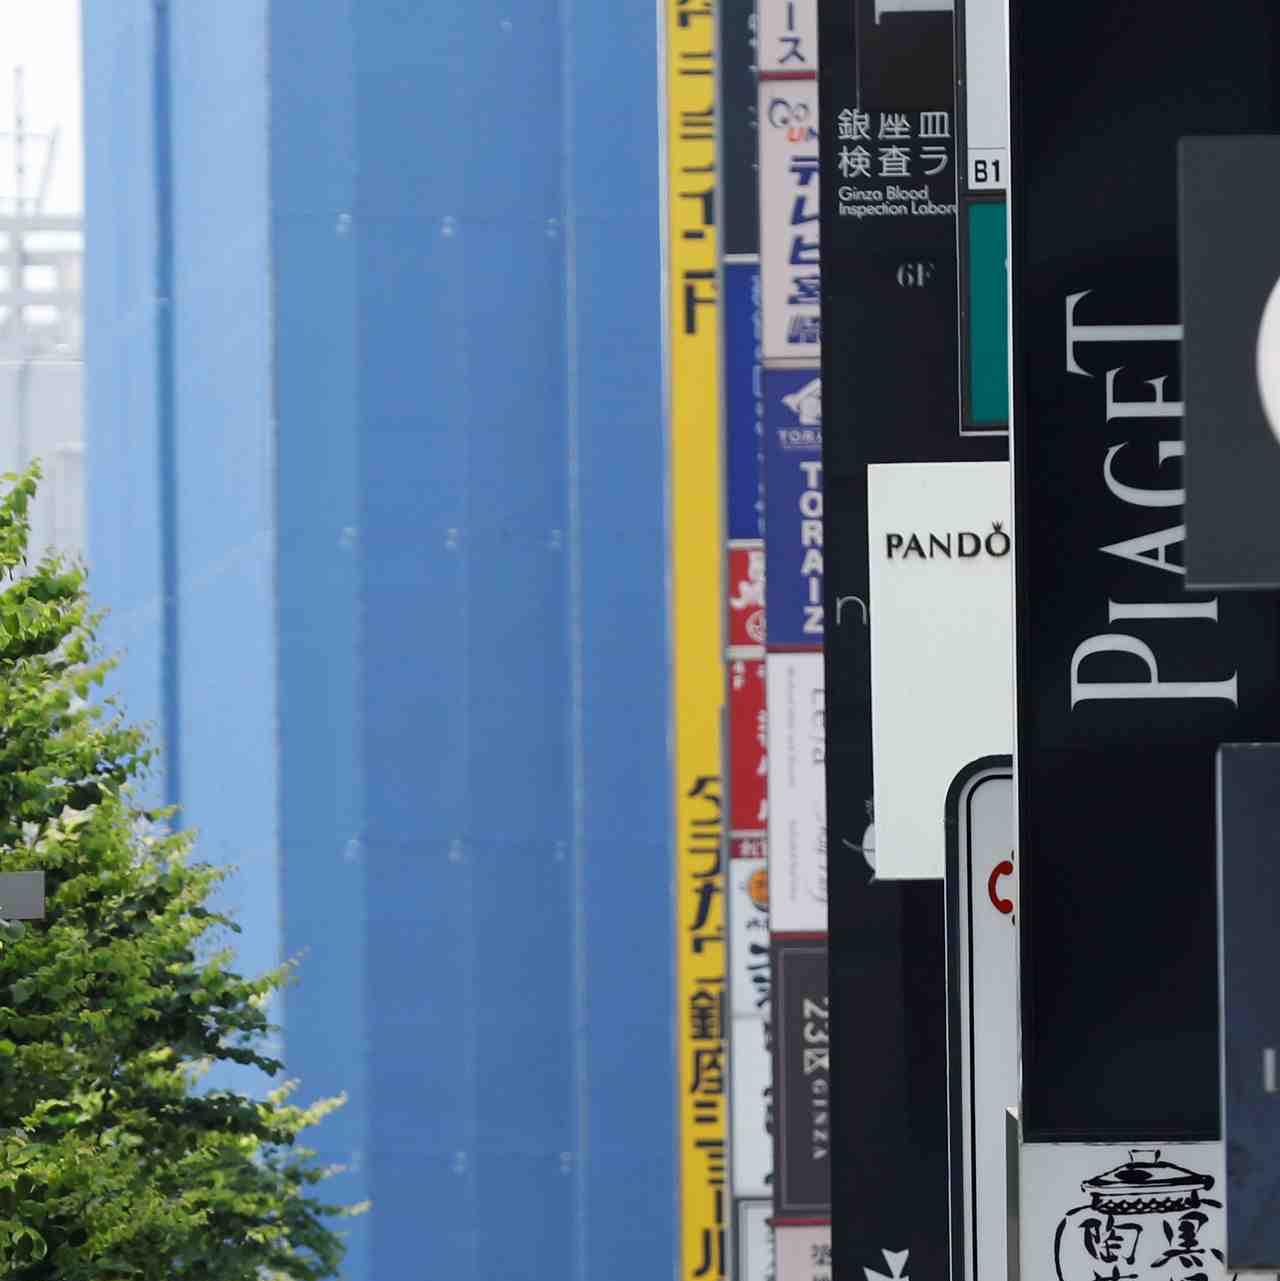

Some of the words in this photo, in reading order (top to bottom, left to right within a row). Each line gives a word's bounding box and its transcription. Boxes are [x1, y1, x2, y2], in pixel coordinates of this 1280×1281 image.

[838, 145, 949, 177] 検査ラ
[974, 160, 1001, 183] B1
[838, 186, 883, 201] Ginza
[886, 185, 929, 200] Blood
[839, 202, 908, 219] Inspection
[896, 262, 936, 287] 6F
[1065, 289, 1238, 711] PIAGET
